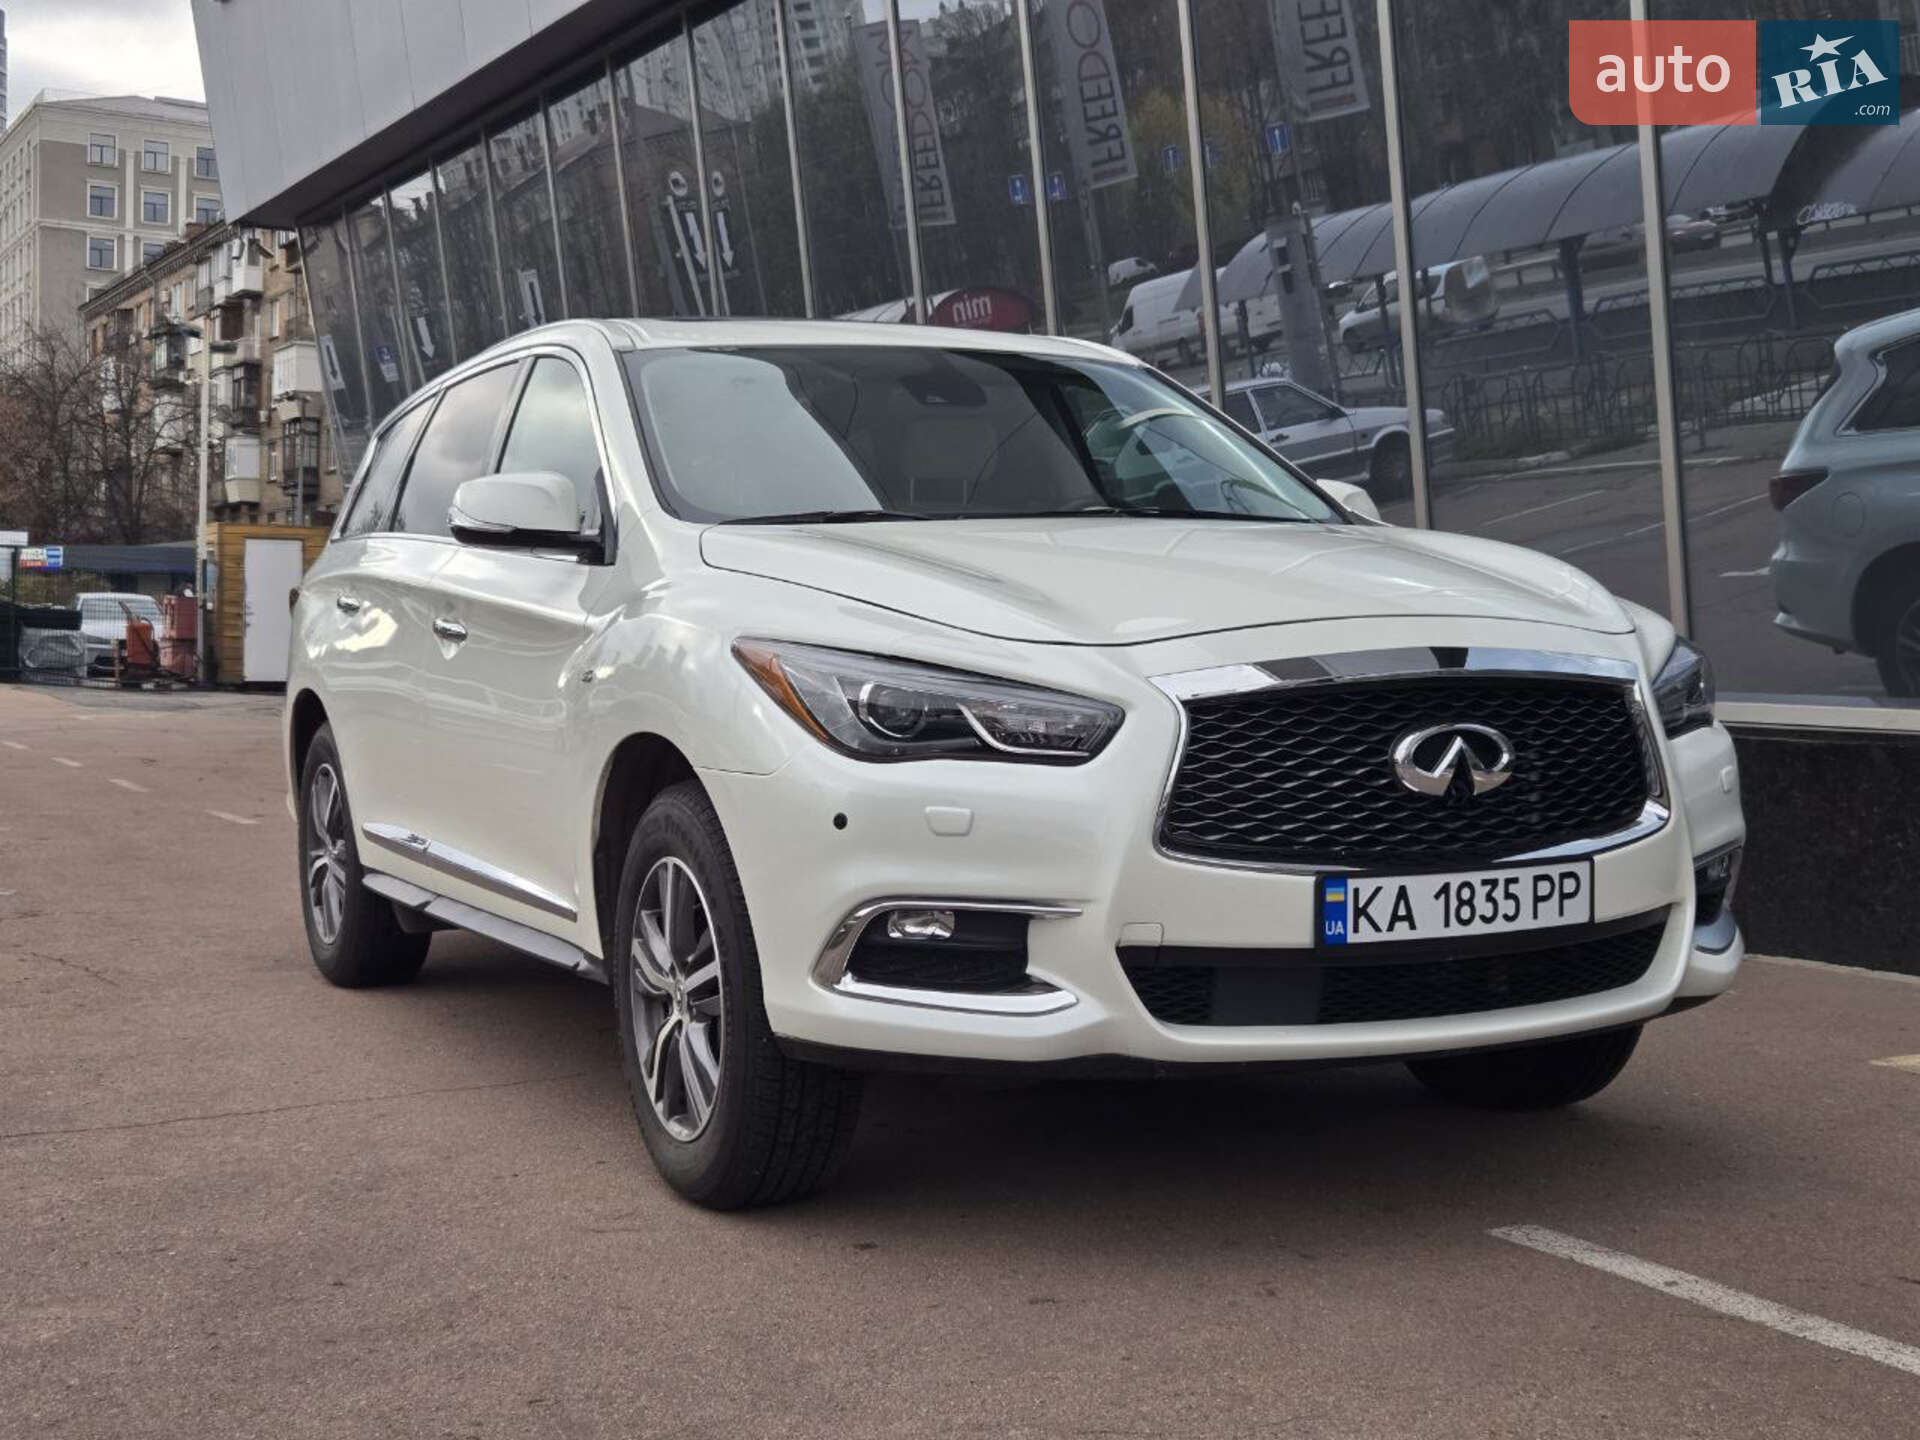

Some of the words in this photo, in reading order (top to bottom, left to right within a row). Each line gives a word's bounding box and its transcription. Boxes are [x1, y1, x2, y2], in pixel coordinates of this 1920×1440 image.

[1352, 885, 1417, 934] KA
[1434, 876, 1521, 929] 1835
[1532, 870, 1582, 920] PP
[1325, 920, 1345, 935] UA
